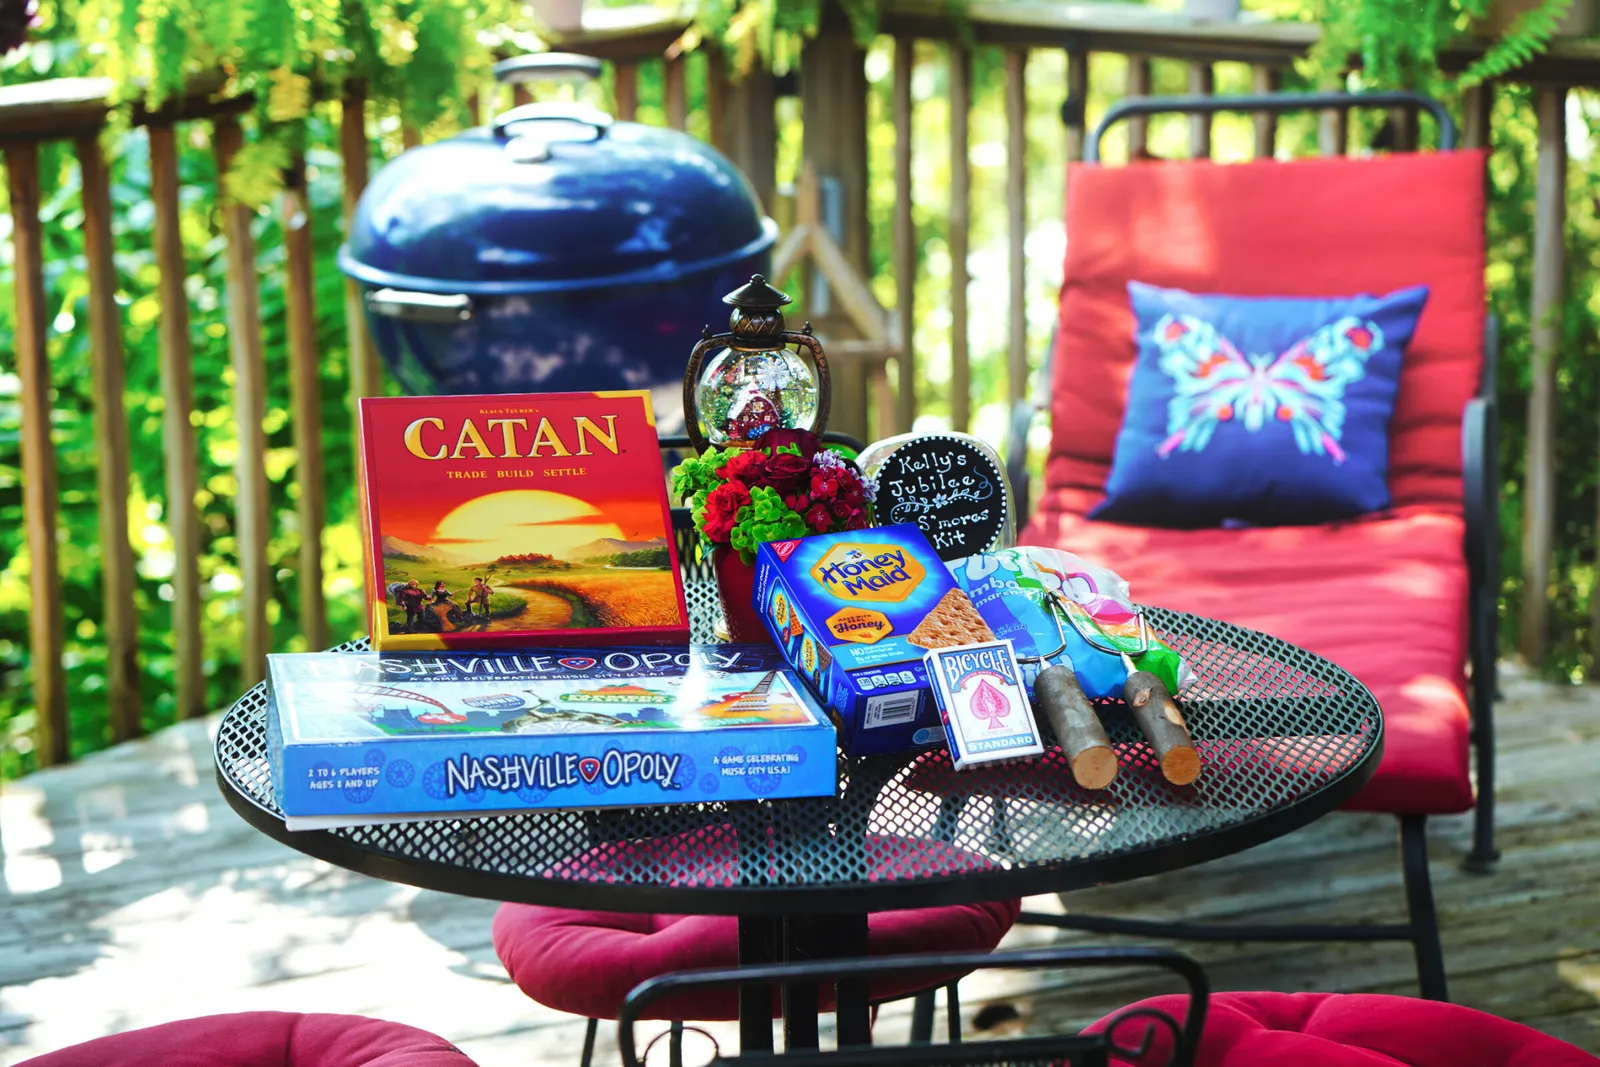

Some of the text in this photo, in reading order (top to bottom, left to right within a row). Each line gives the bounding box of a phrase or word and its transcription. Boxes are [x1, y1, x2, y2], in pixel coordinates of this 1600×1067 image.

[404, 414, 620, 460] CATAN
[899, 452, 967, 474] Kelly's
[447, 468, 587, 479] TRADE BUILD SETTLE
[889, 474, 975, 498] Jubilee
[918, 509, 990, 531] S'mores
[932, 530, 966, 550] Kit
[820, 548, 908, 593] Honey
[842, 564, 912, 596] Maid
[833, 620, 885, 633] Honey
[850, 648, 865, 656] NO
[944, 649, 1015, 690] BICYCLE
[968, 736, 1032, 751] STANDARD
[713, 754, 799, 764] A GAME CELEBRATING
[317, 769, 328, 777] TO
[340, 767, 380, 776] PLAYERS
[447, 750, 679, 795] NASHVILLE OPOLY
[722, 767, 746, 776] MUSIC
[748, 767, 766, 775] CITY
[310, 780, 334, 790] AGES
[345, 780, 363, 789] AND
[366, 779, 378, 788] UP
